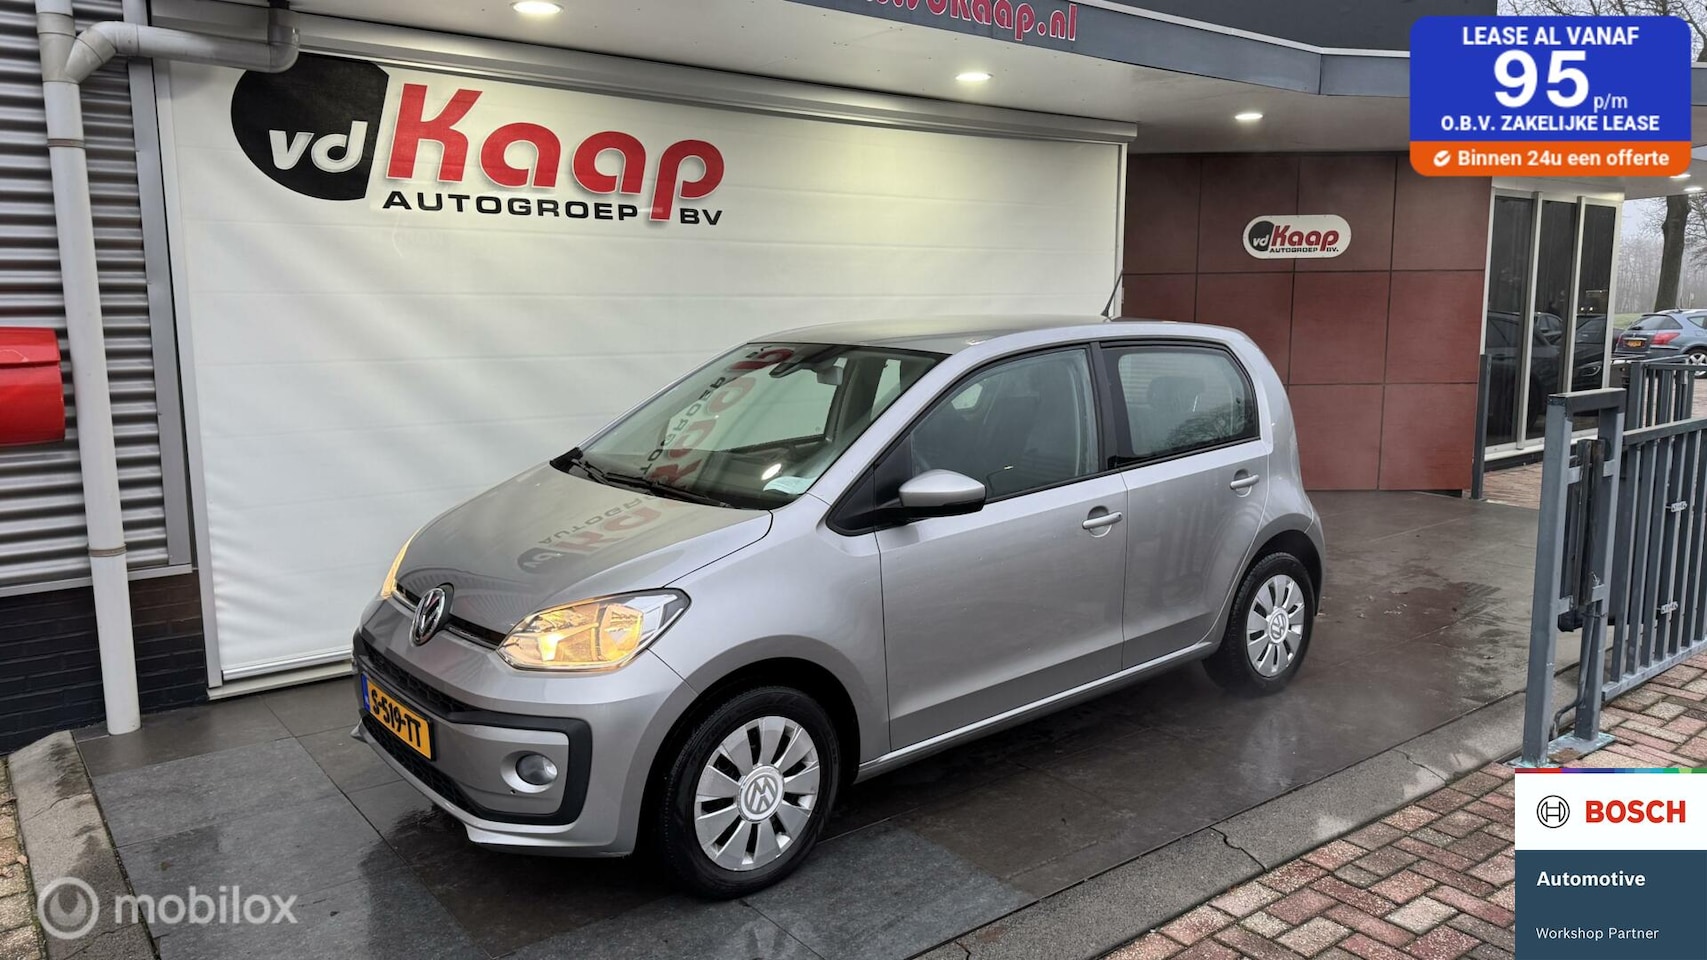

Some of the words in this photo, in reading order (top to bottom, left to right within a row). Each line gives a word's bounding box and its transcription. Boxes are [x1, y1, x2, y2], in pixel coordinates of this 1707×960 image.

[268, 120, 369, 174] vd
[386, 82, 725, 221] Kaap
[382, 190, 639, 221] AUTOGROEP
[679, 207, 724, 226] BV
[1270, 225, 1340, 252] Kaap
[371, 688, 422, 748] S-519-TT
